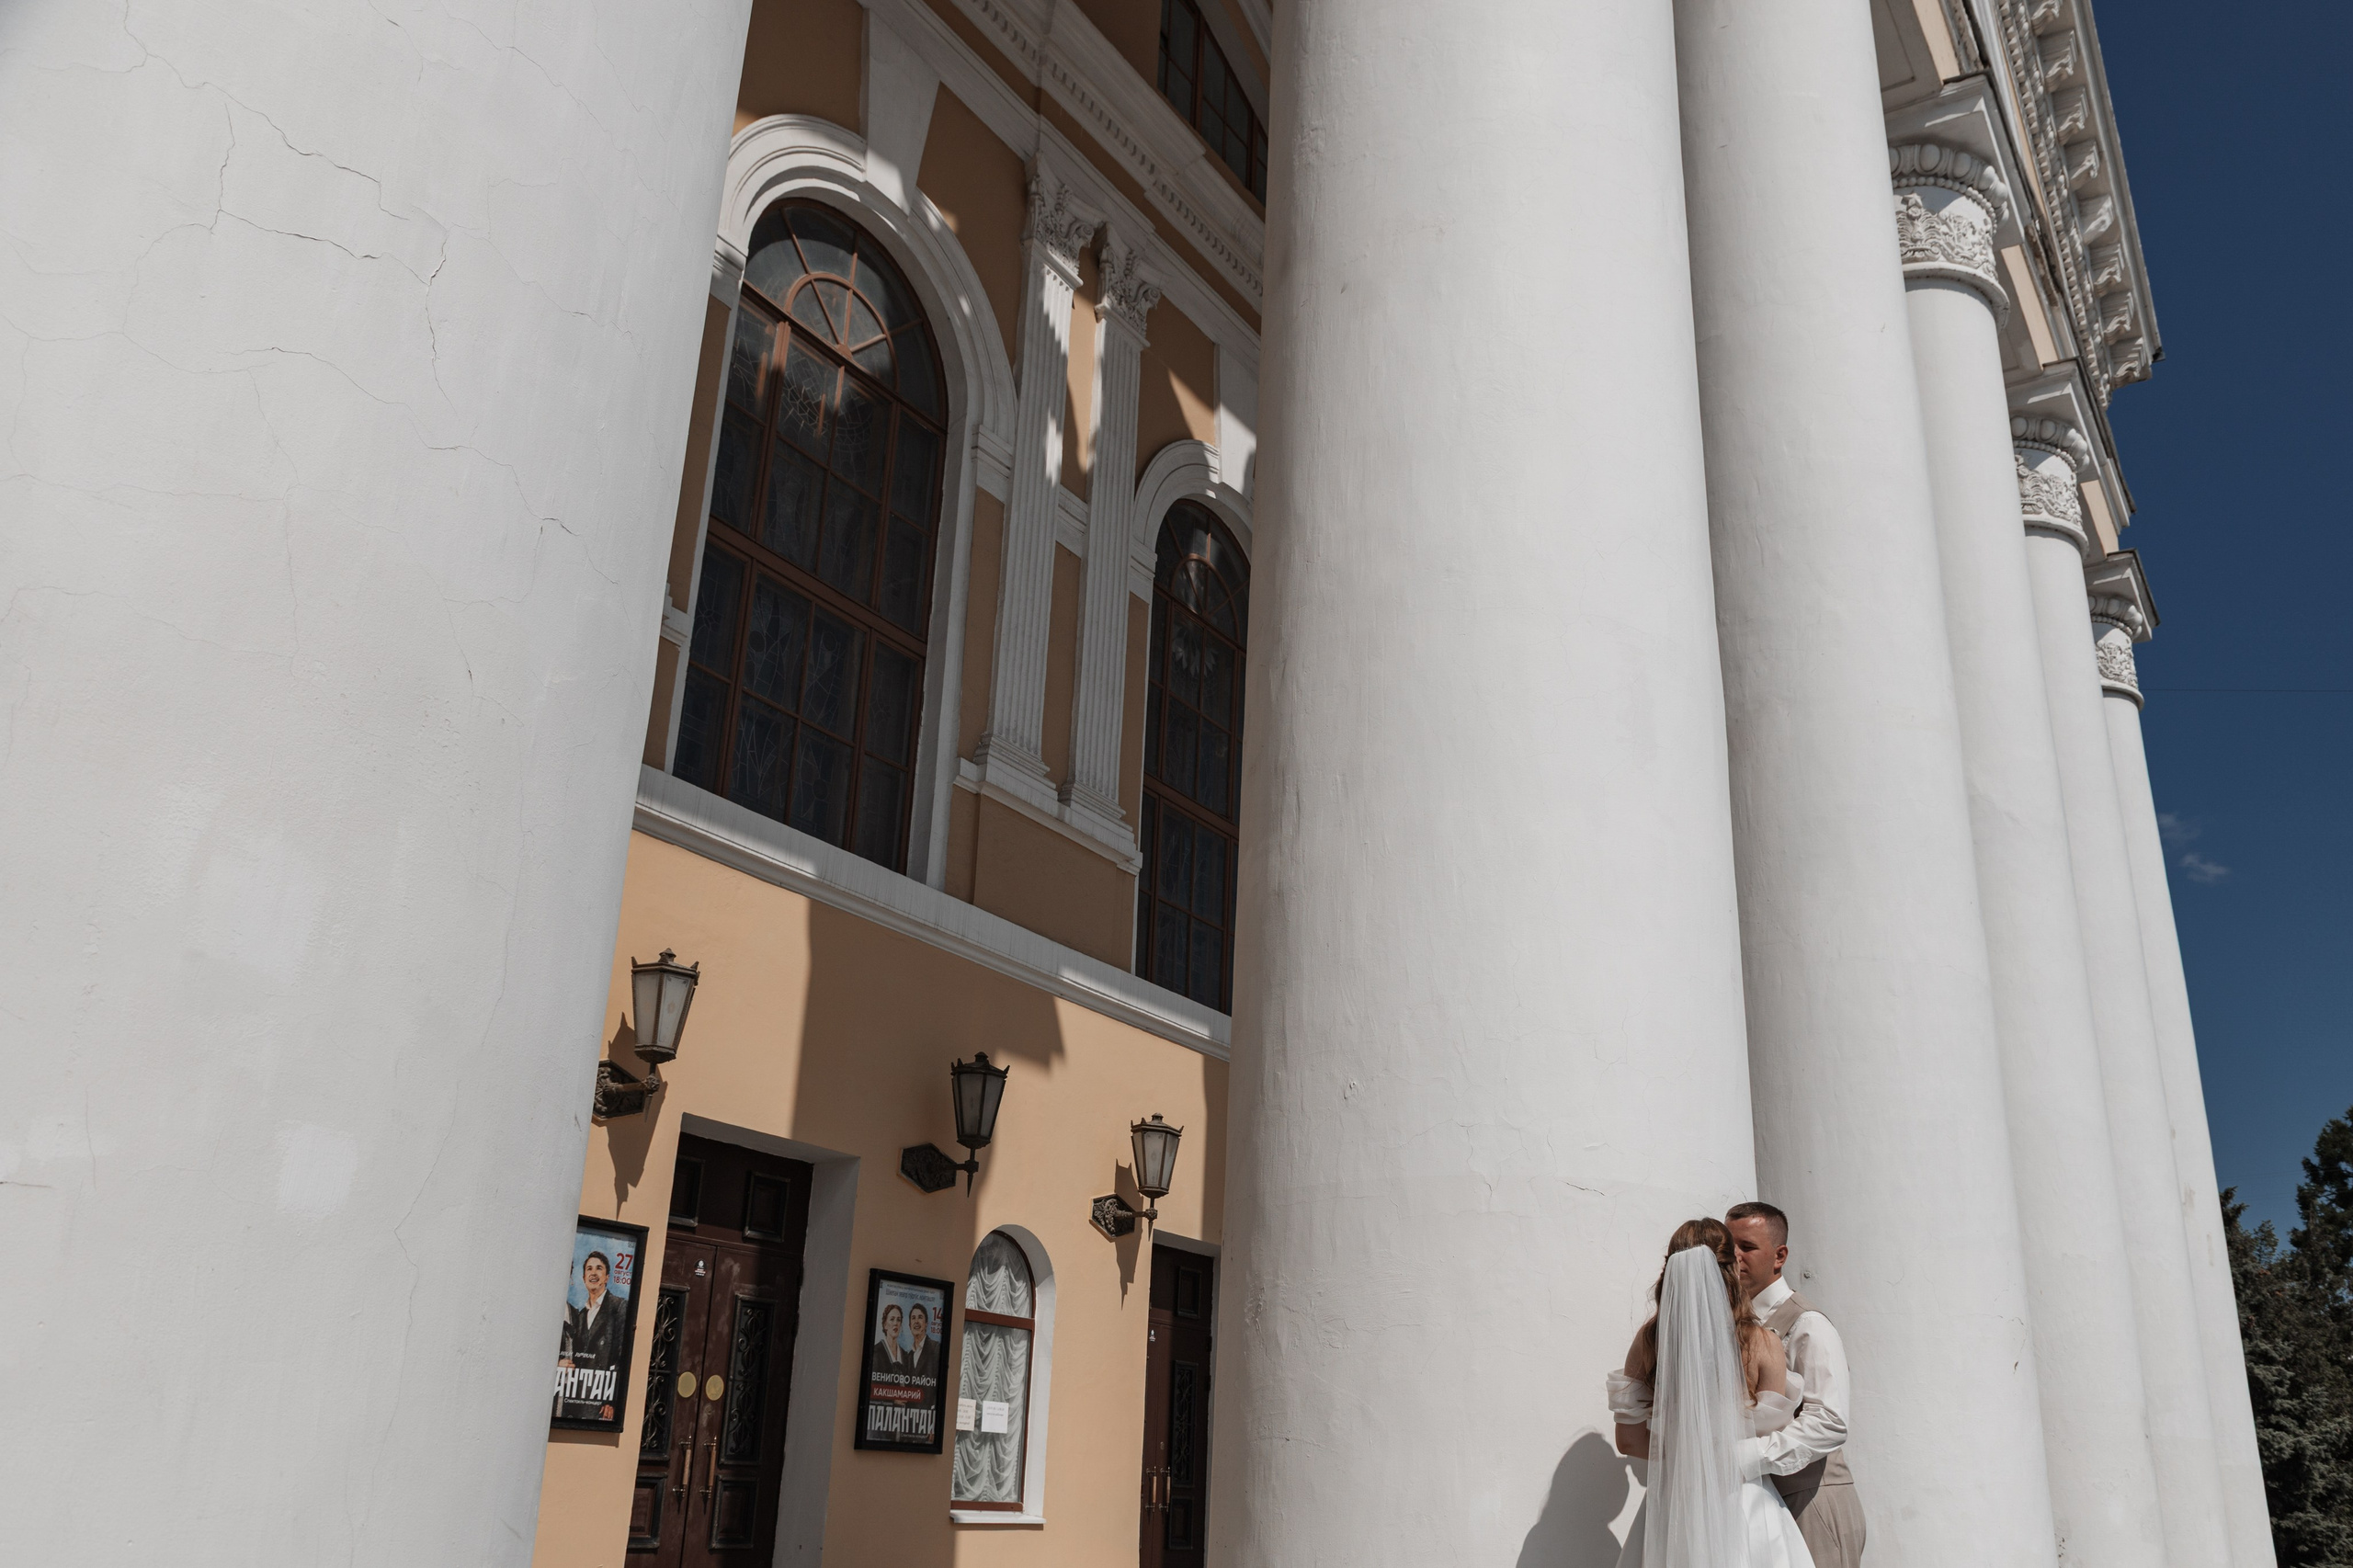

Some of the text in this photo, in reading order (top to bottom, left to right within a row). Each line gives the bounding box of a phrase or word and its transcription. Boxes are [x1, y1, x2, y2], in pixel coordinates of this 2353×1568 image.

[615, 1253, 633, 1270] 27
[932, 1307, 942, 1321] 14
[553, 1365, 617, 1401] АНТАЙ
[871, 1371, 937, 1387] ВЕНИГОВО РАЙОН
[873, 1388, 921, 1399] КАКШАМАРИЙ
[867, 1405, 936, 1435] ПАЛАНТАЙ
